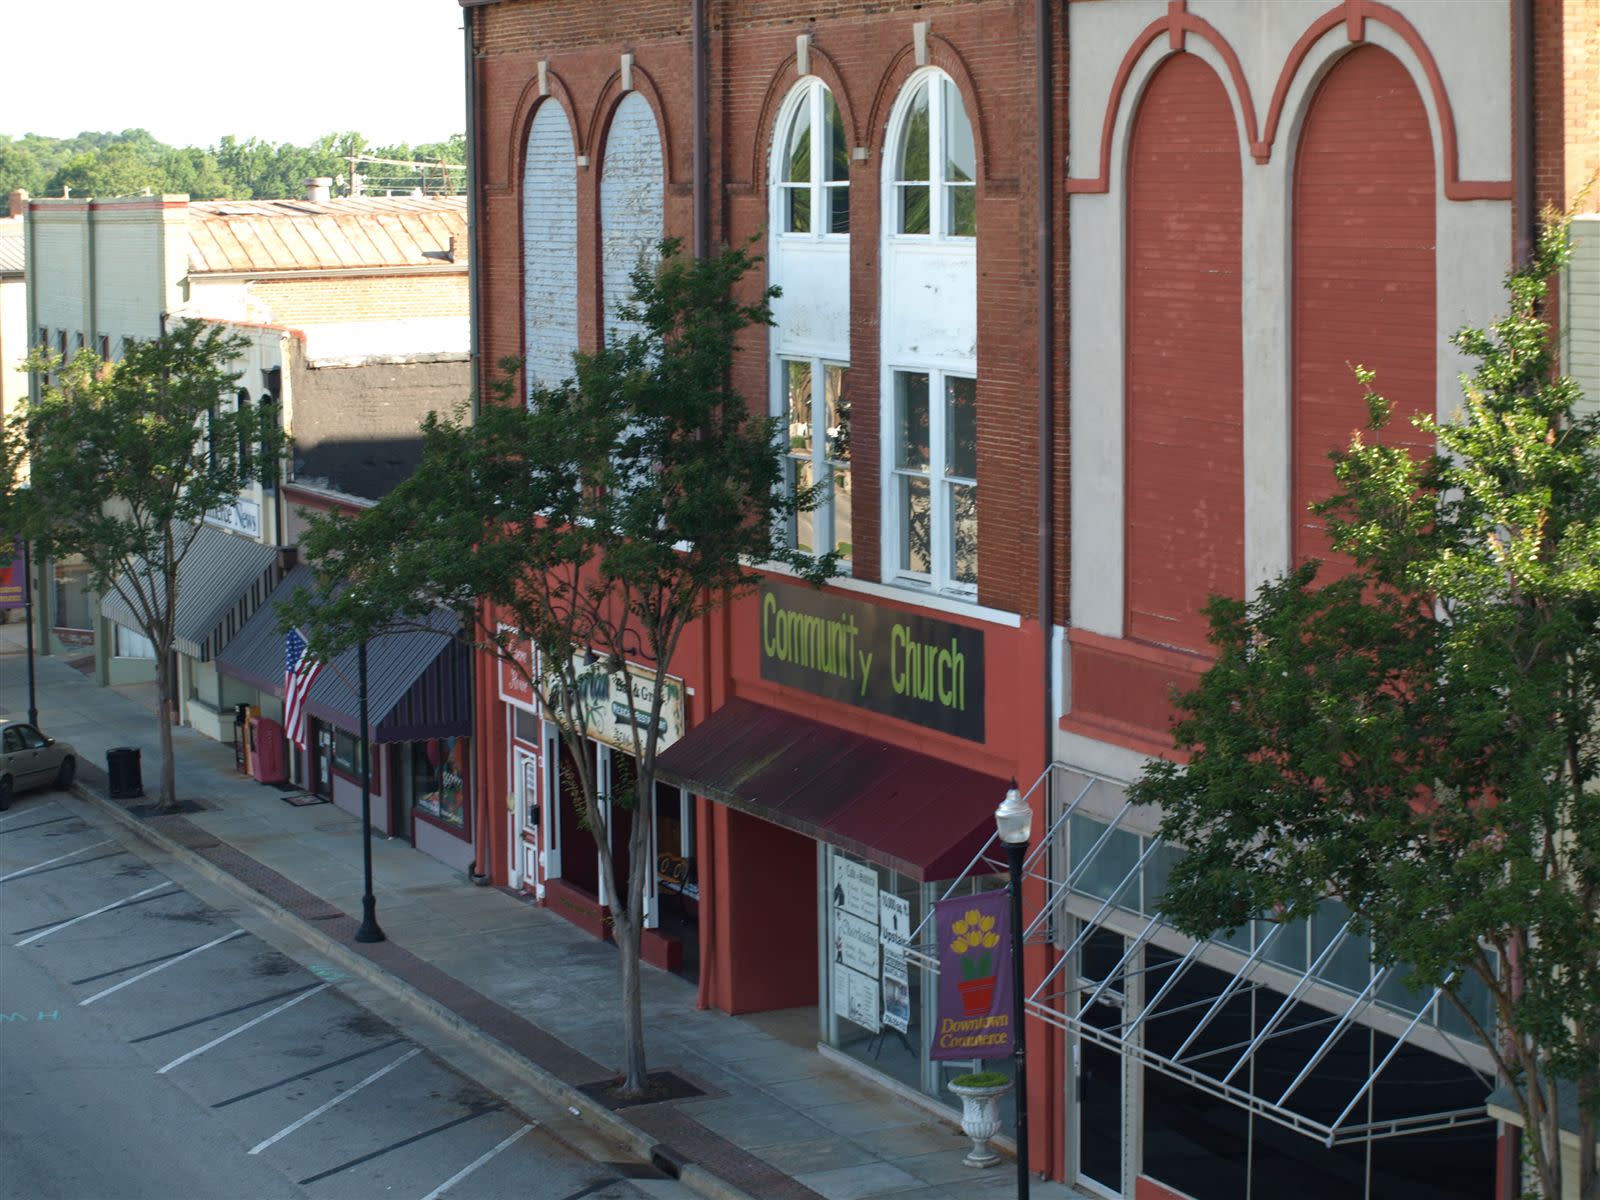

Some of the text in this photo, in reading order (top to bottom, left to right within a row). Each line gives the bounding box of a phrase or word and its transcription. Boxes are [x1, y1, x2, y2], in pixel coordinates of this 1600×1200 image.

[763, 592, 965, 711] Community Church
[942, 1014, 1009, 1034] Downtown
[940, 1032, 1008, 1049] Commerce
